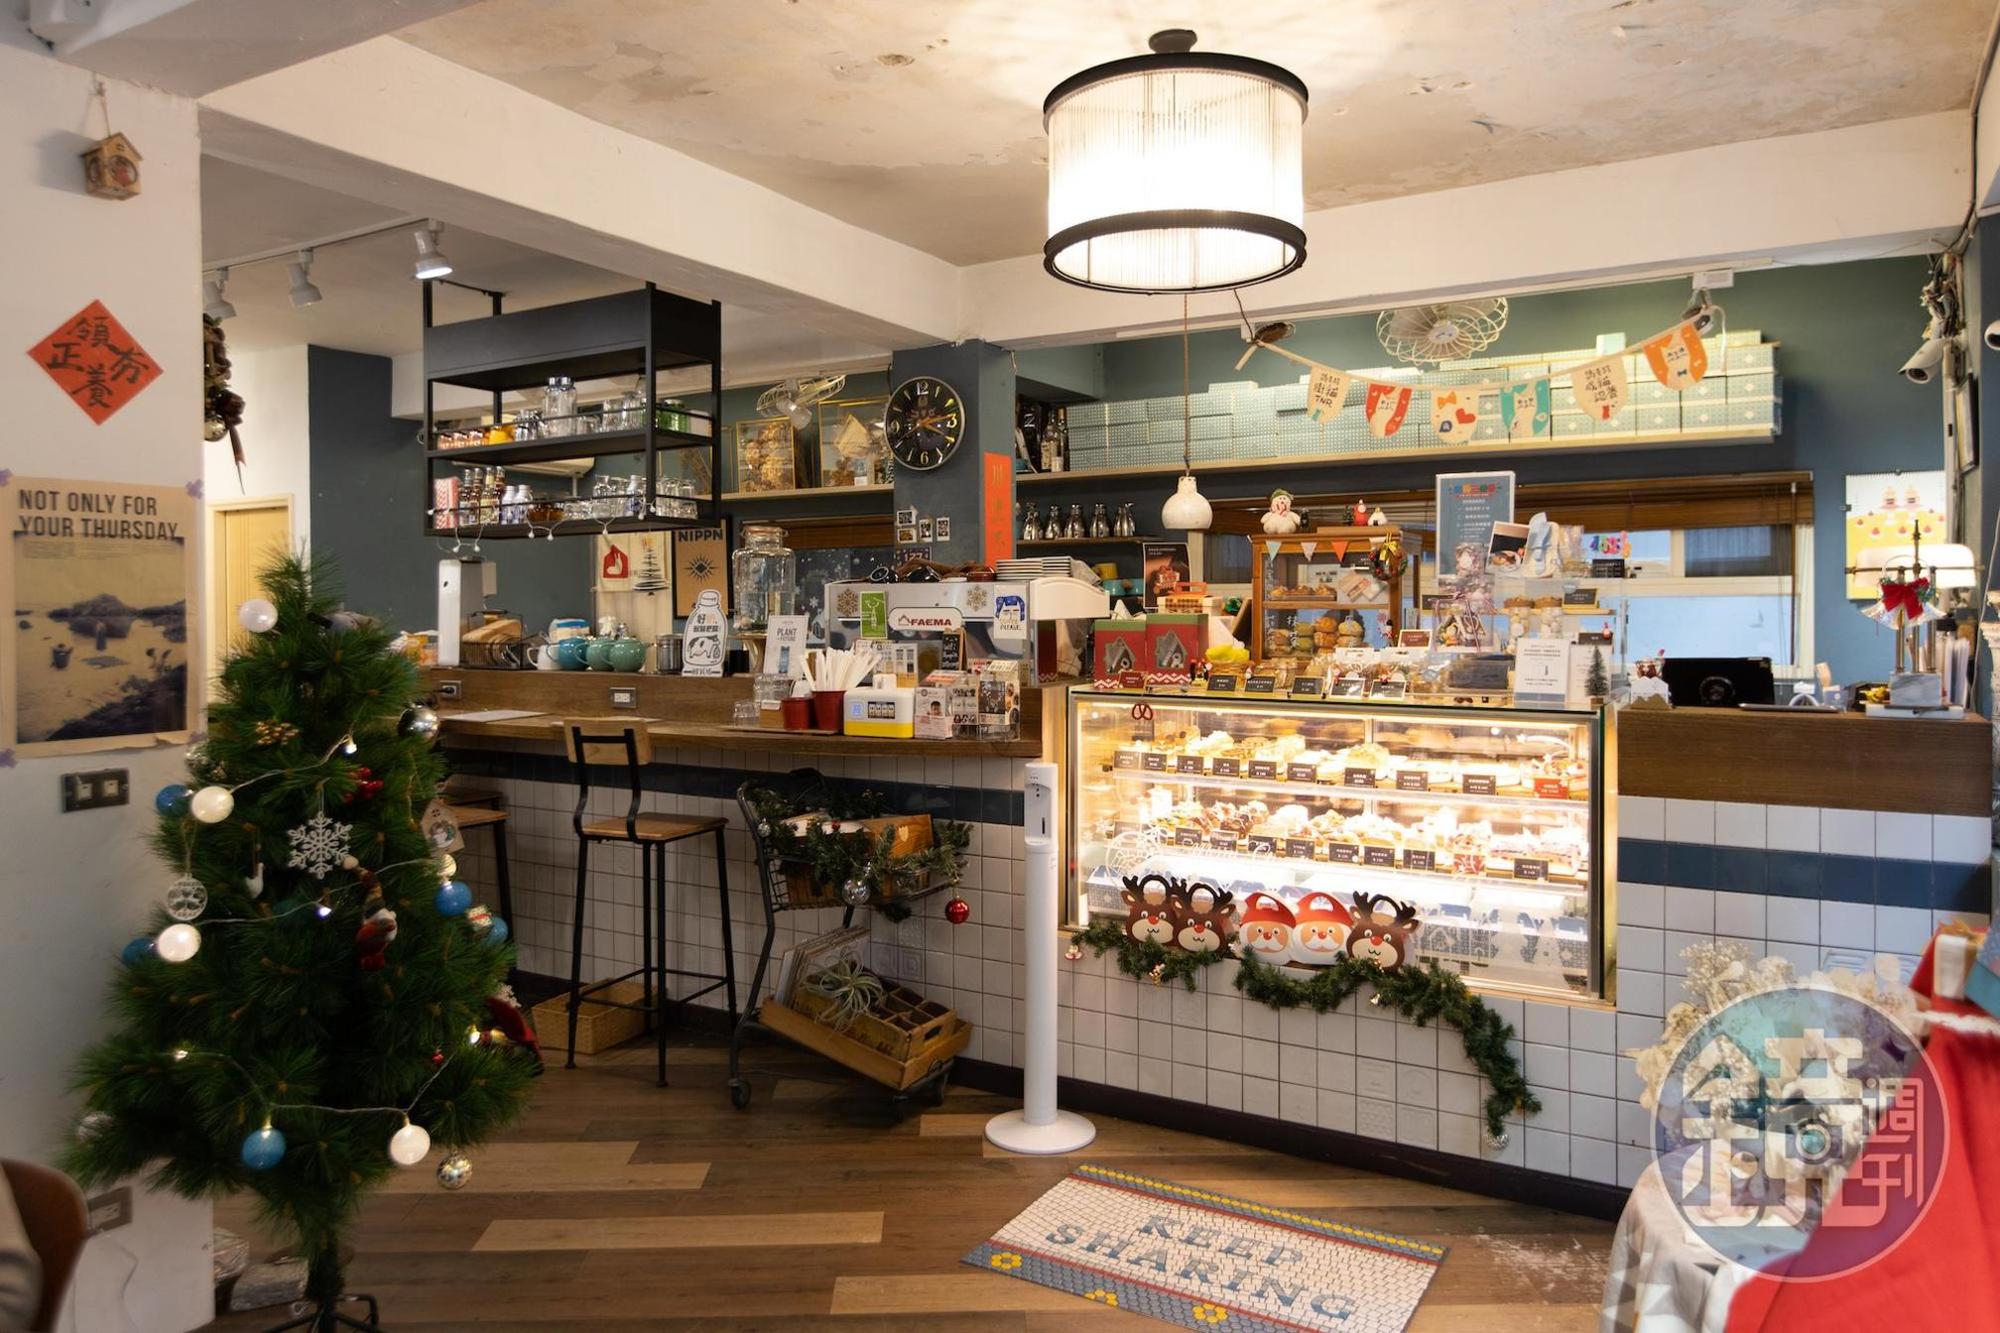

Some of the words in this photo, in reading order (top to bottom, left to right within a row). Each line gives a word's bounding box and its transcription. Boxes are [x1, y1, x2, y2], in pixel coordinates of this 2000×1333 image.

[916, 382, 929, 395] 12
[1315, 394, 1333, 408] TNR
[946, 412, 958, 429] 3
[920, 451, 929, 465] 6
[19, 489, 60, 511] NOT
[67, 492, 116, 514] ONLY
[123, 496, 157, 516] FOR
[19, 515, 74, 538] YOUR
[81, 518, 178, 540] THURSDAY
[678, 528, 723, 542] NIPPN
[911, 618, 952, 627] FAEMA
[1138, 1215, 1304, 1268] KEEP
[1045, 1222, 1356, 1321] SHARING
